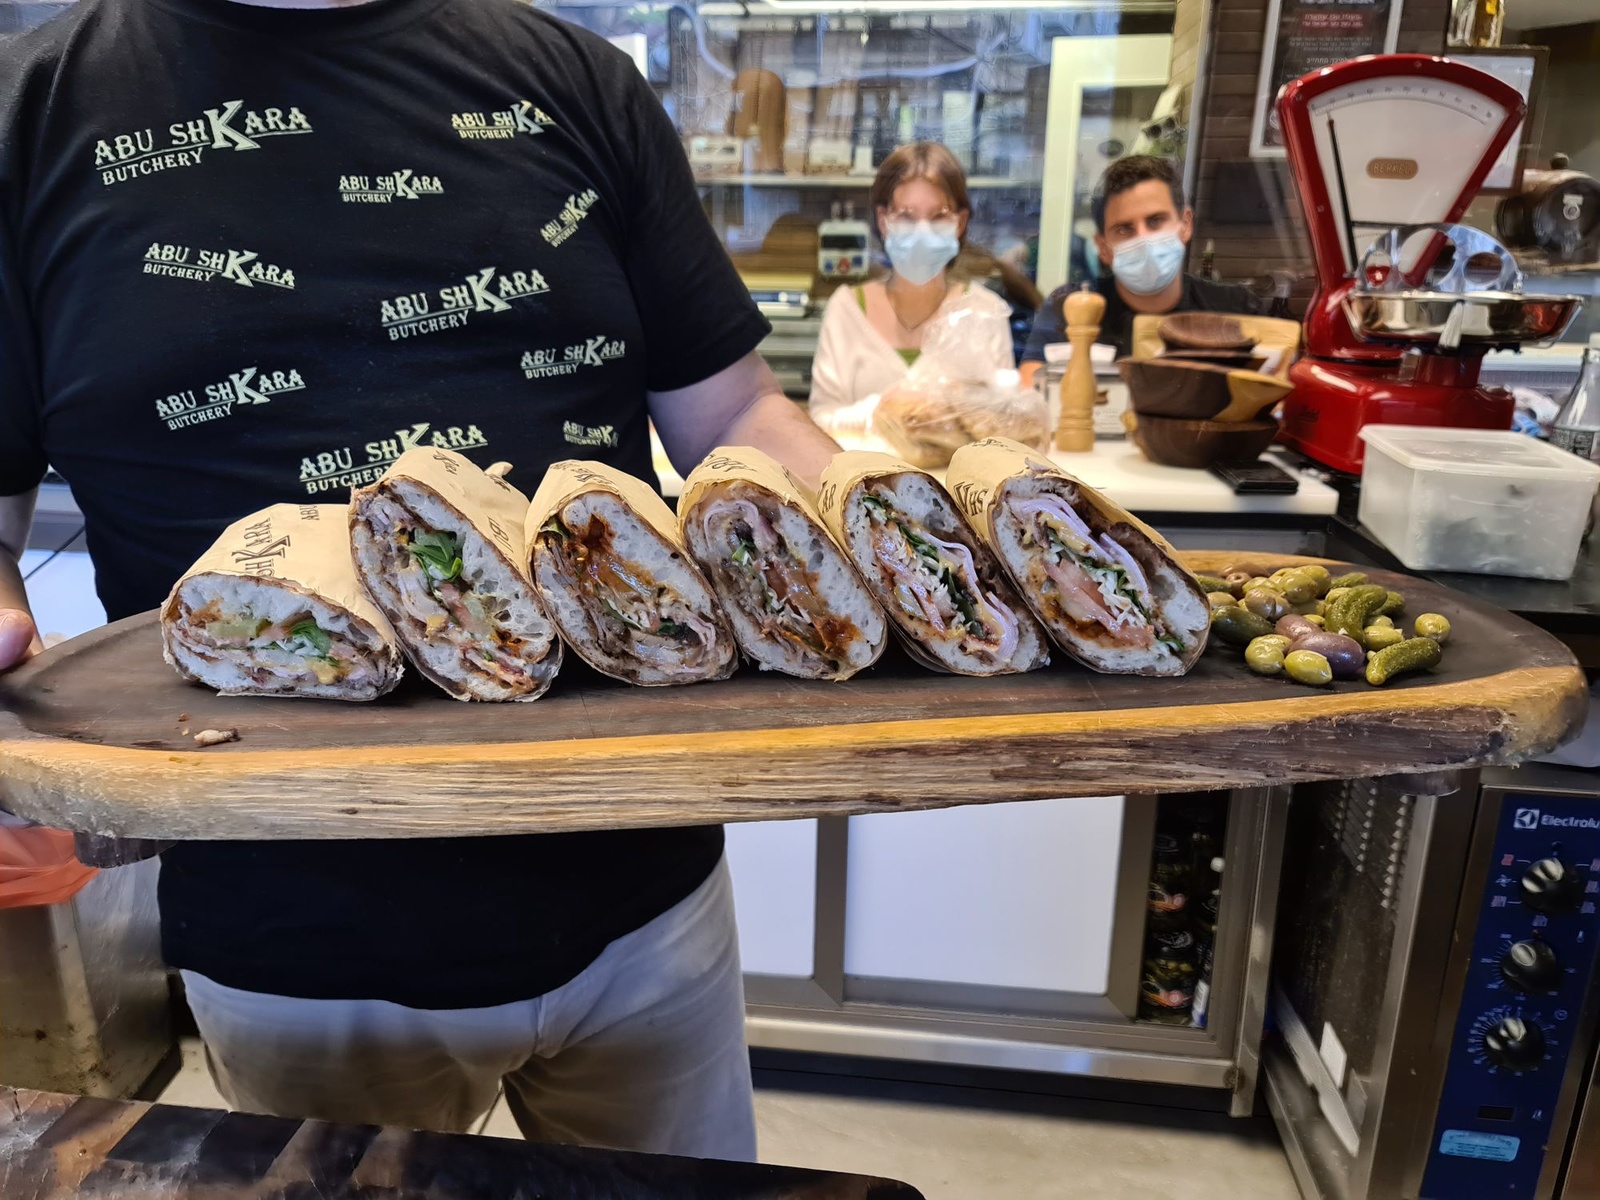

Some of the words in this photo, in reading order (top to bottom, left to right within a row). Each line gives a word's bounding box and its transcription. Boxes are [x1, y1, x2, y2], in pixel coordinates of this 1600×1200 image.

[95, 129, 153, 165] ABU
[169, 100, 312, 150] SHKARA
[451, 113, 486, 128] ABU
[494, 100, 553, 134] SHKA
[458, 128, 514, 139] BUTCHERY
[102, 147, 203, 185] BUTCHERY
[339, 175, 369, 190] ABU
[376, 169, 443, 199] SHKARA
[342, 192, 393, 203] BUTCHERY
[540, 219, 562, 242] ABU
[558, 188, 599, 223] SHKARA
[551, 223, 579, 247] BUTCHERY
[143, 263, 216, 282] BUTCHERY
[144, 243, 190, 263] ABU
[197, 249, 295, 287] SHKARA
[381, 293, 429, 323] ABU
[439, 266, 550, 313] SHKARA
[388, 309, 470, 341] BUTCHERY
[520, 348, 556, 368] ABU
[563, 335, 626, 366] SHKARA
[525, 362, 579, 379] BUTCHERY
[155, 390, 197, 418] ABU
[205, 367, 305, 405] SHKARA
[167, 403, 233, 431] BUTCHERY
[563, 420, 584, 437] ABU
[300, 447, 353, 479] ABU
[306, 465, 391, 494] BUTCHER
[1541, 814, 1600, 829] Electrolu
